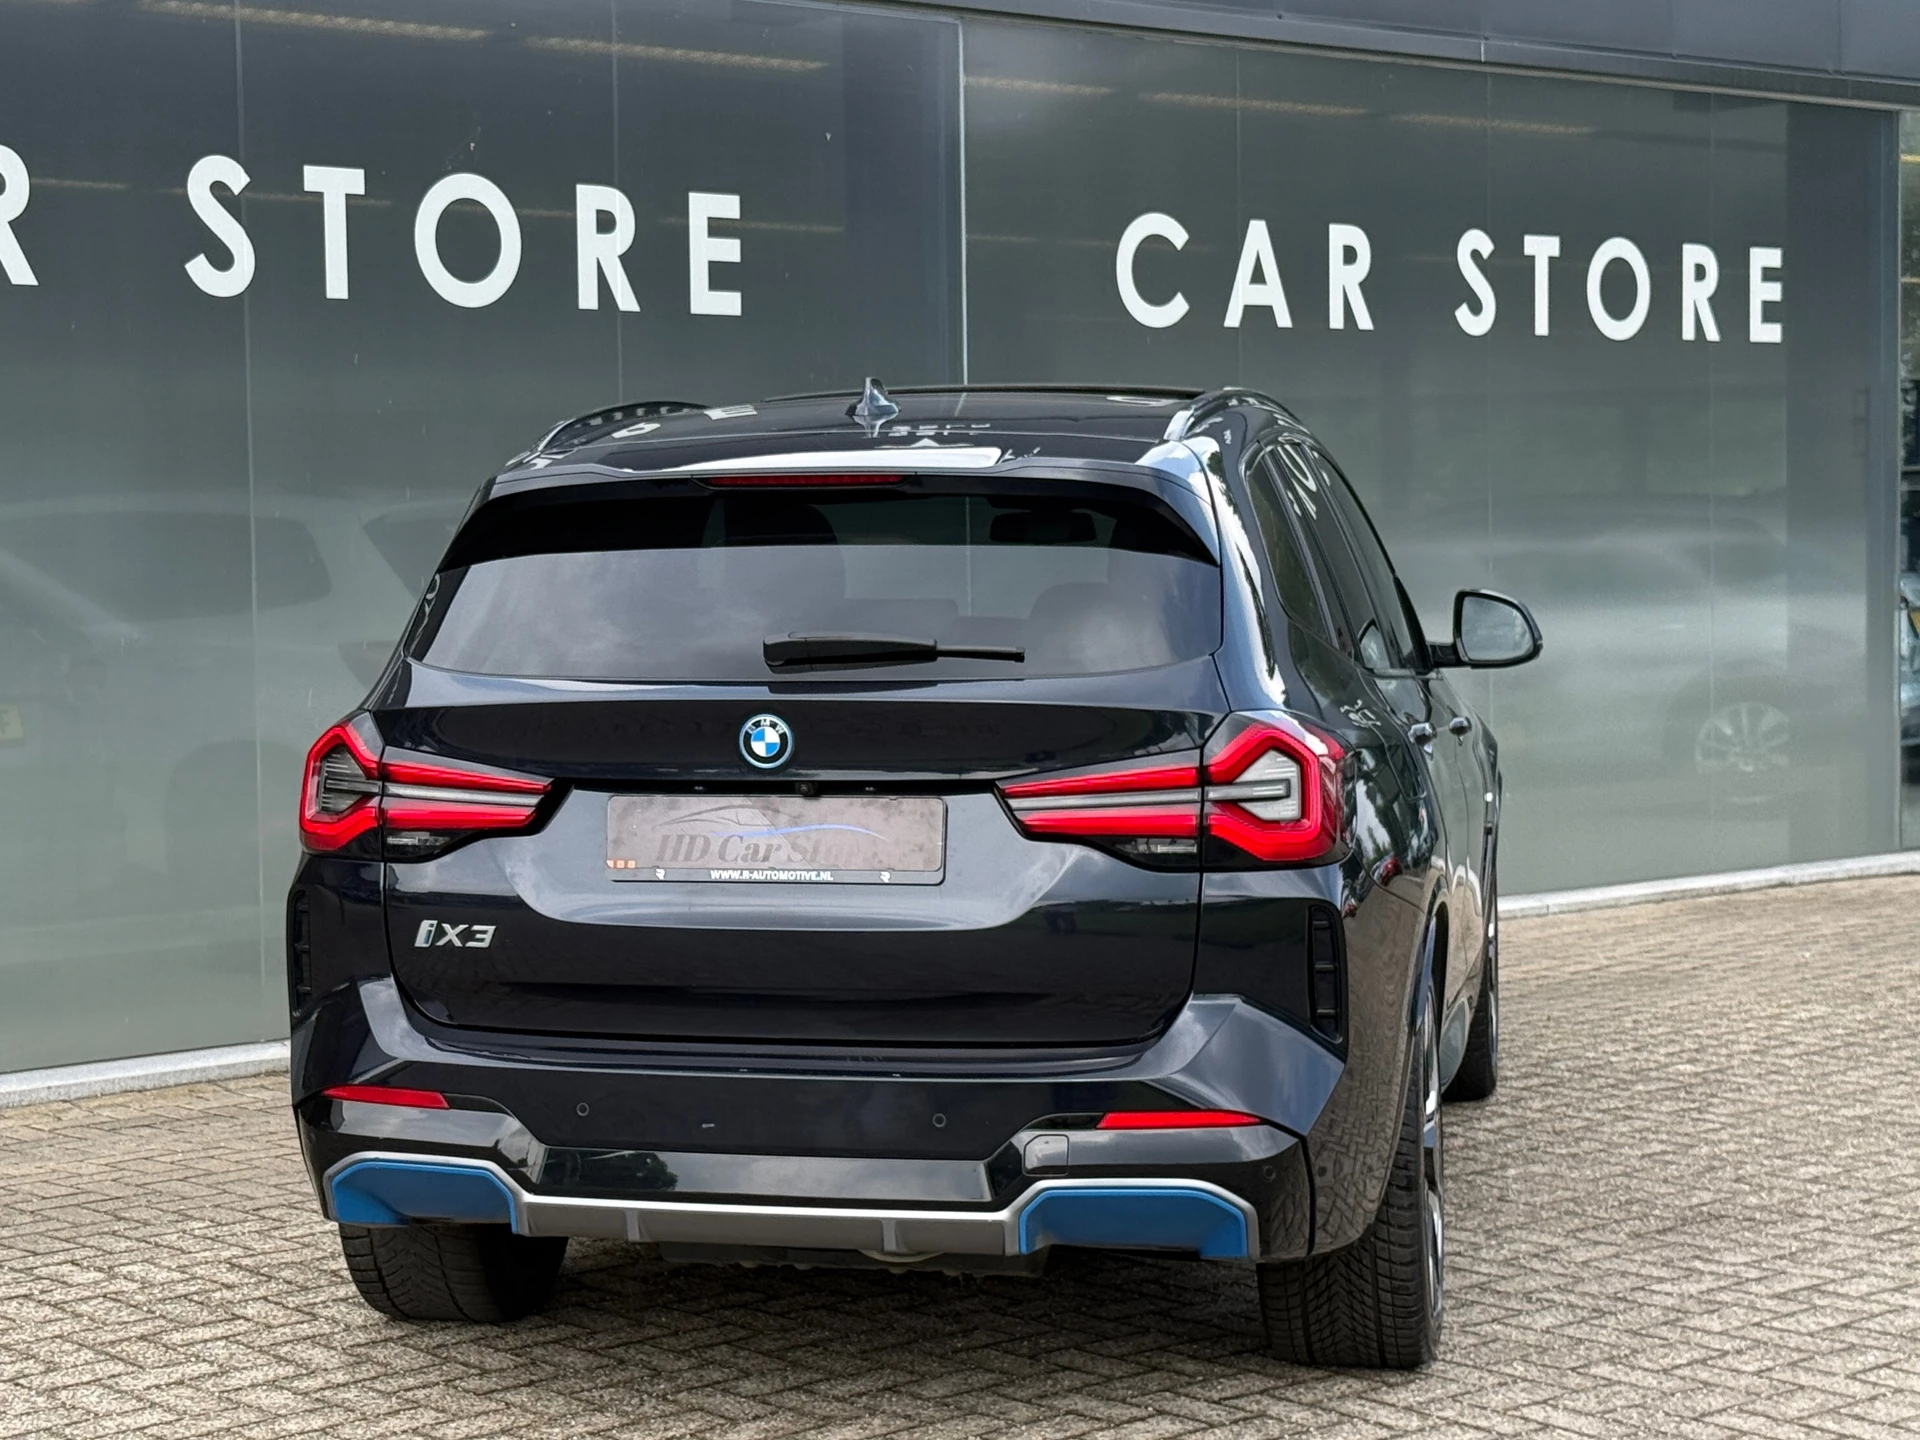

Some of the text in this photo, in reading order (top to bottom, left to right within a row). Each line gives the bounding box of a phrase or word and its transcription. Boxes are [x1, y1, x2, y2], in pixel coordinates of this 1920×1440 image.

[185, 154, 742, 316] STORE
[1115, 212, 1782, 343] CAR STORE
[716, 834, 782, 864] Car
